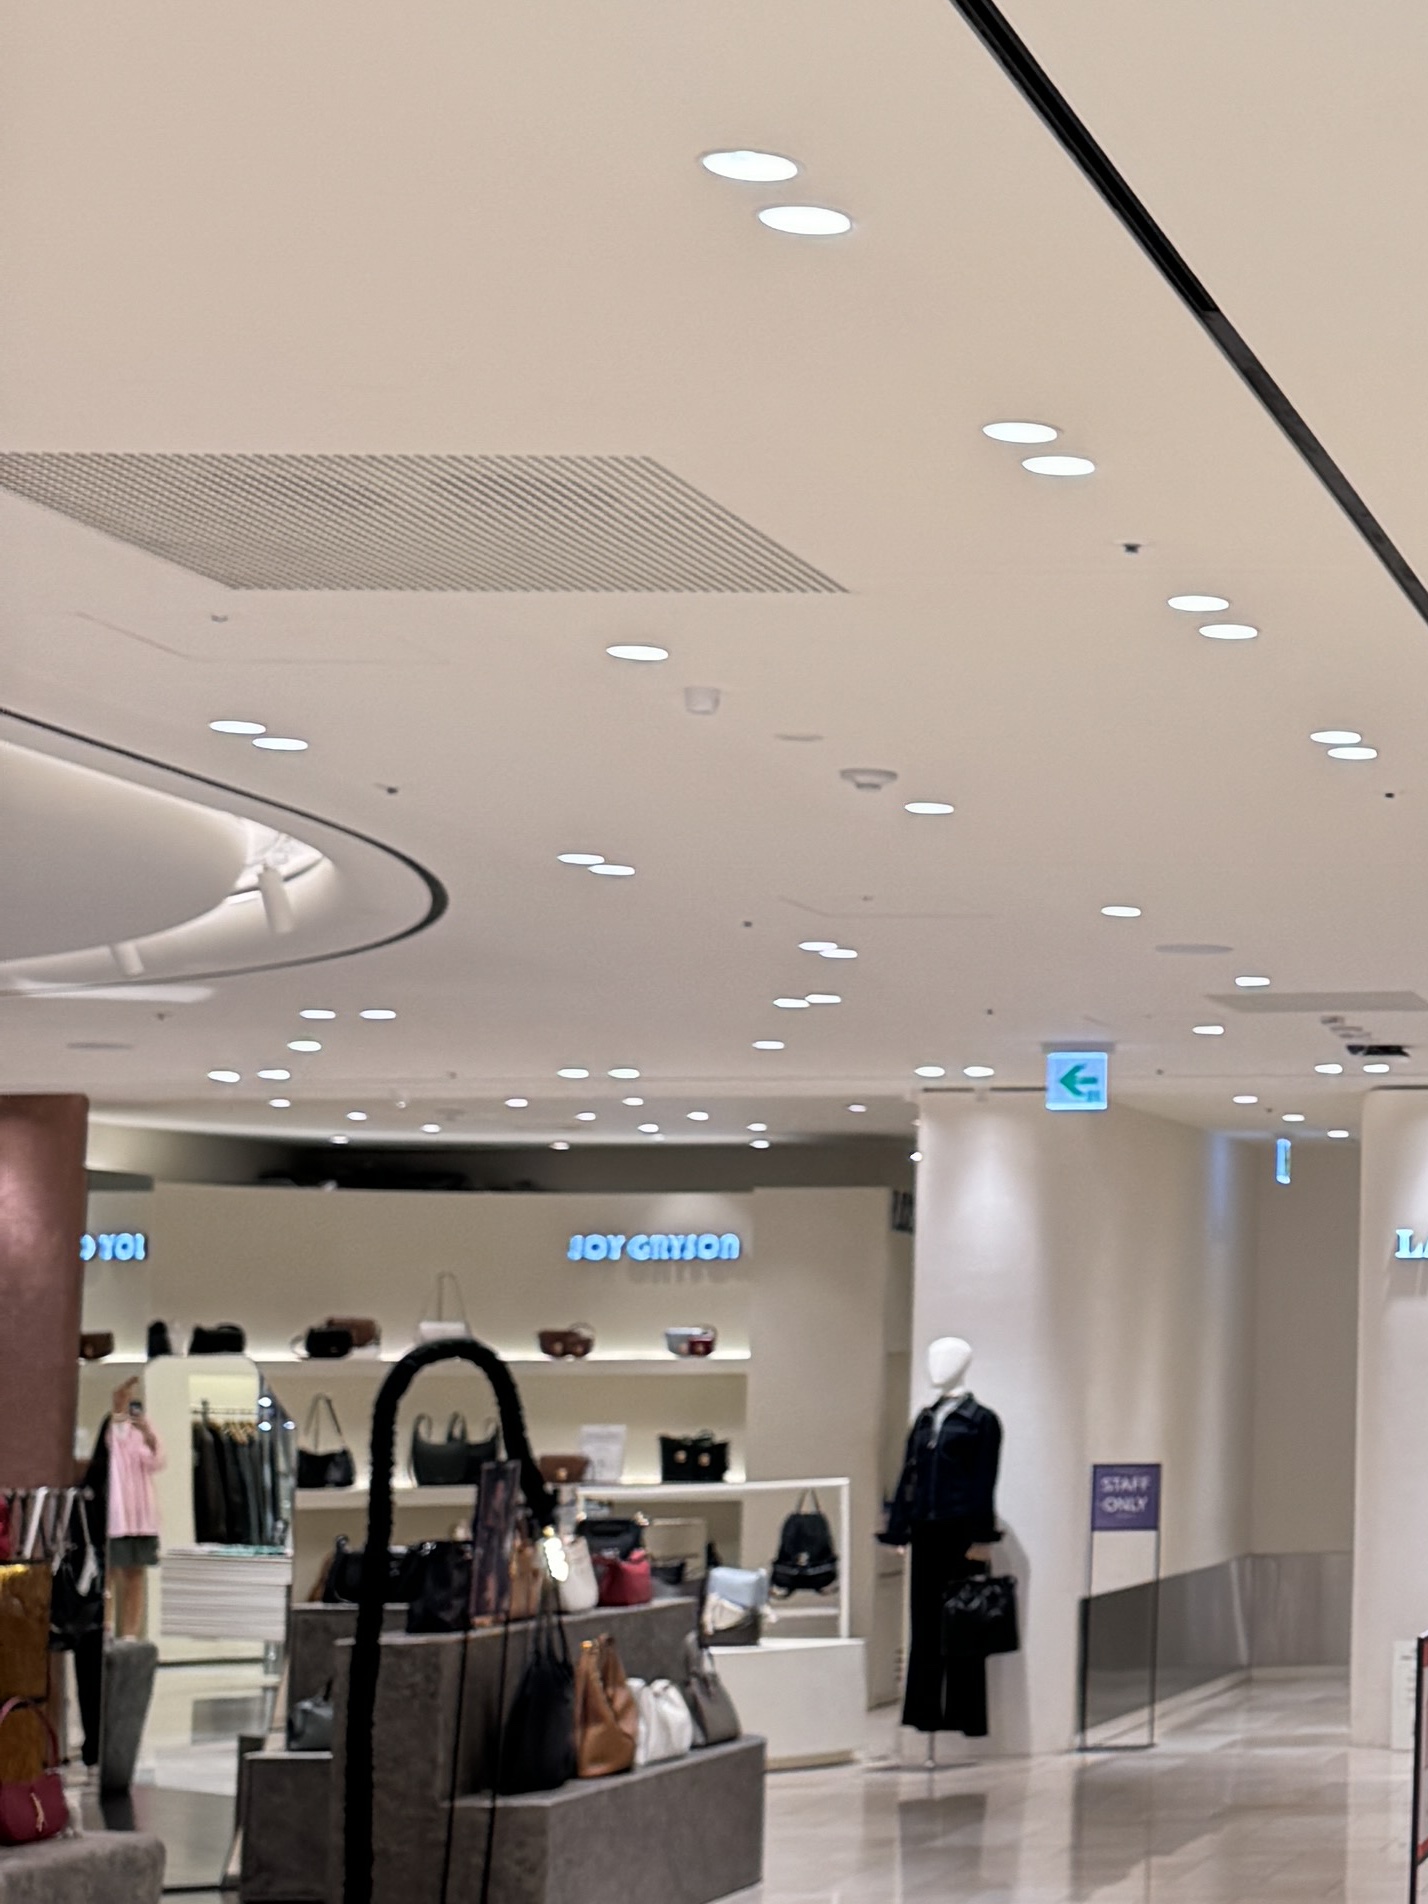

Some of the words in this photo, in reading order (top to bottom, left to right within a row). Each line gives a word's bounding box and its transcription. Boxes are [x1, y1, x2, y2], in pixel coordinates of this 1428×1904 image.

[566, 1233, 627, 1262] JOY
[1100, 1475, 1151, 1493] STAFF
[1101, 1495, 1149, 1513] ONLY
